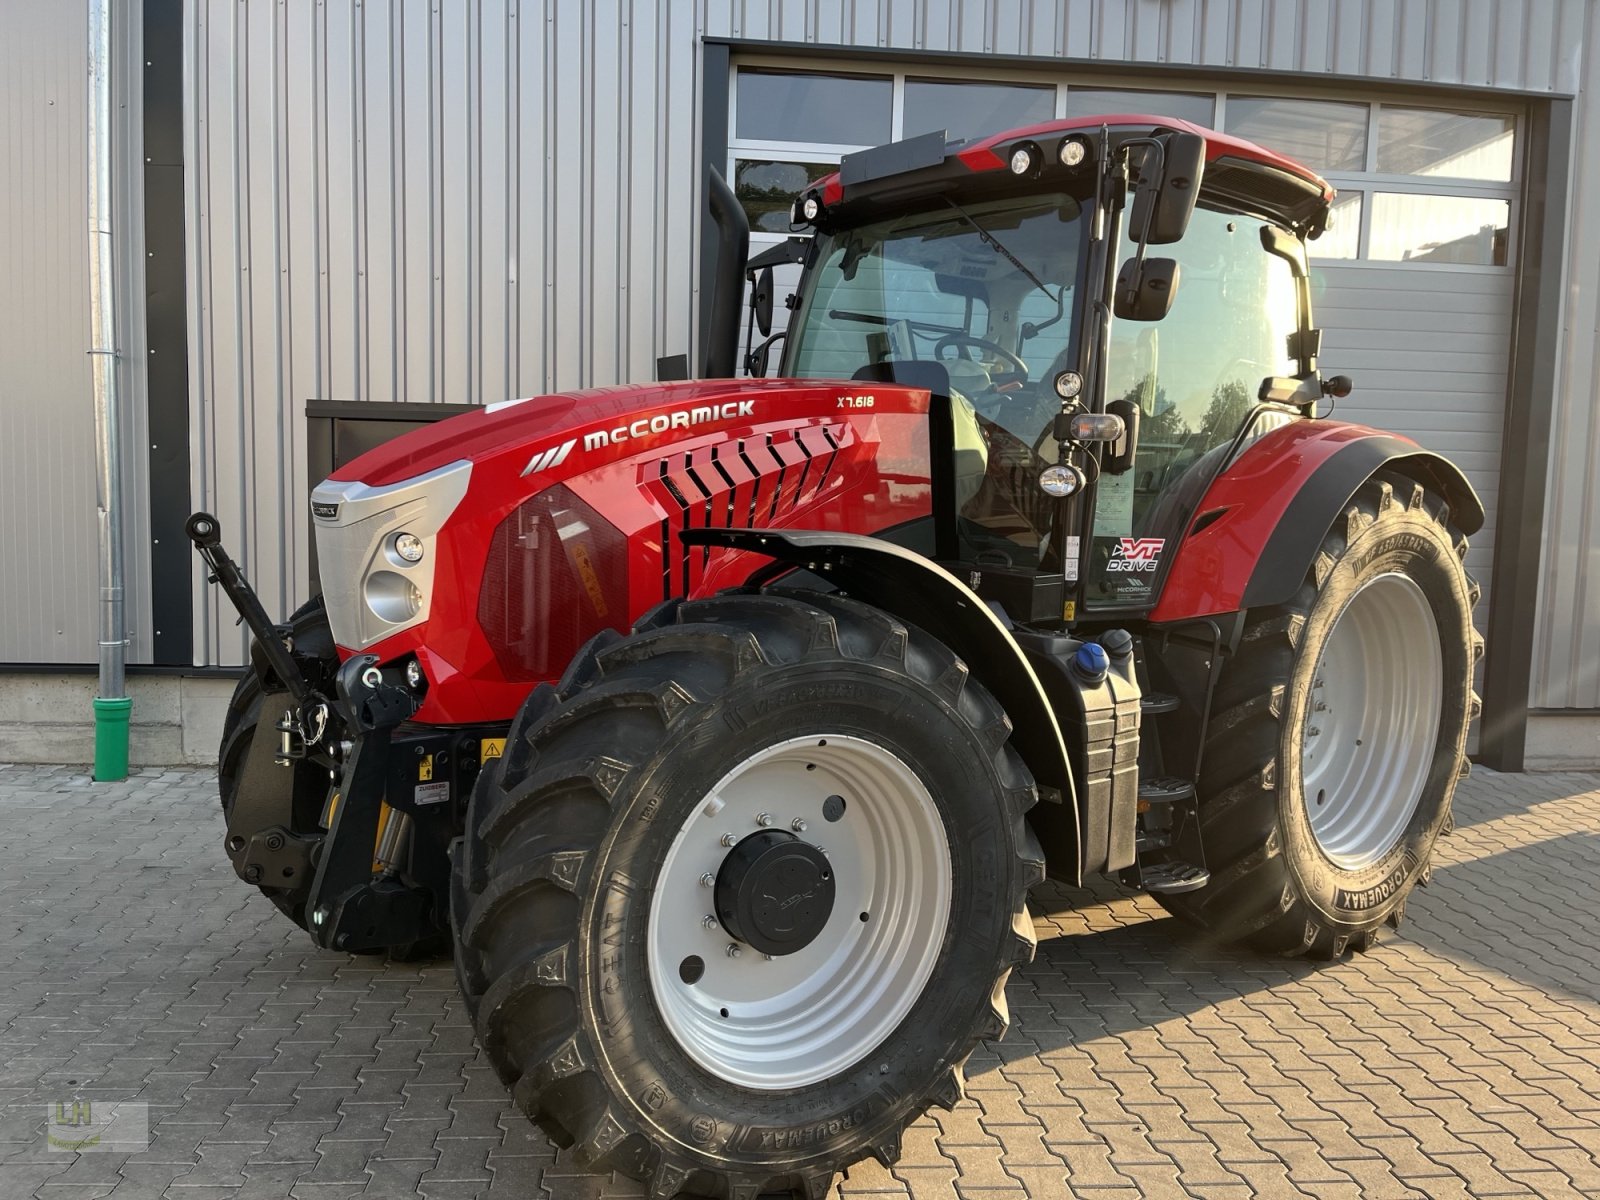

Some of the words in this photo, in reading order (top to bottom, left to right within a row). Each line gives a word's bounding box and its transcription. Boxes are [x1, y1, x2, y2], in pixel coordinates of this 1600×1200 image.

[1106, 560, 1157, 572] DRIVE
[1343, 863, 1410, 909] TORQUEMAX
[759, 1103, 875, 1150] TORQUEMAX
